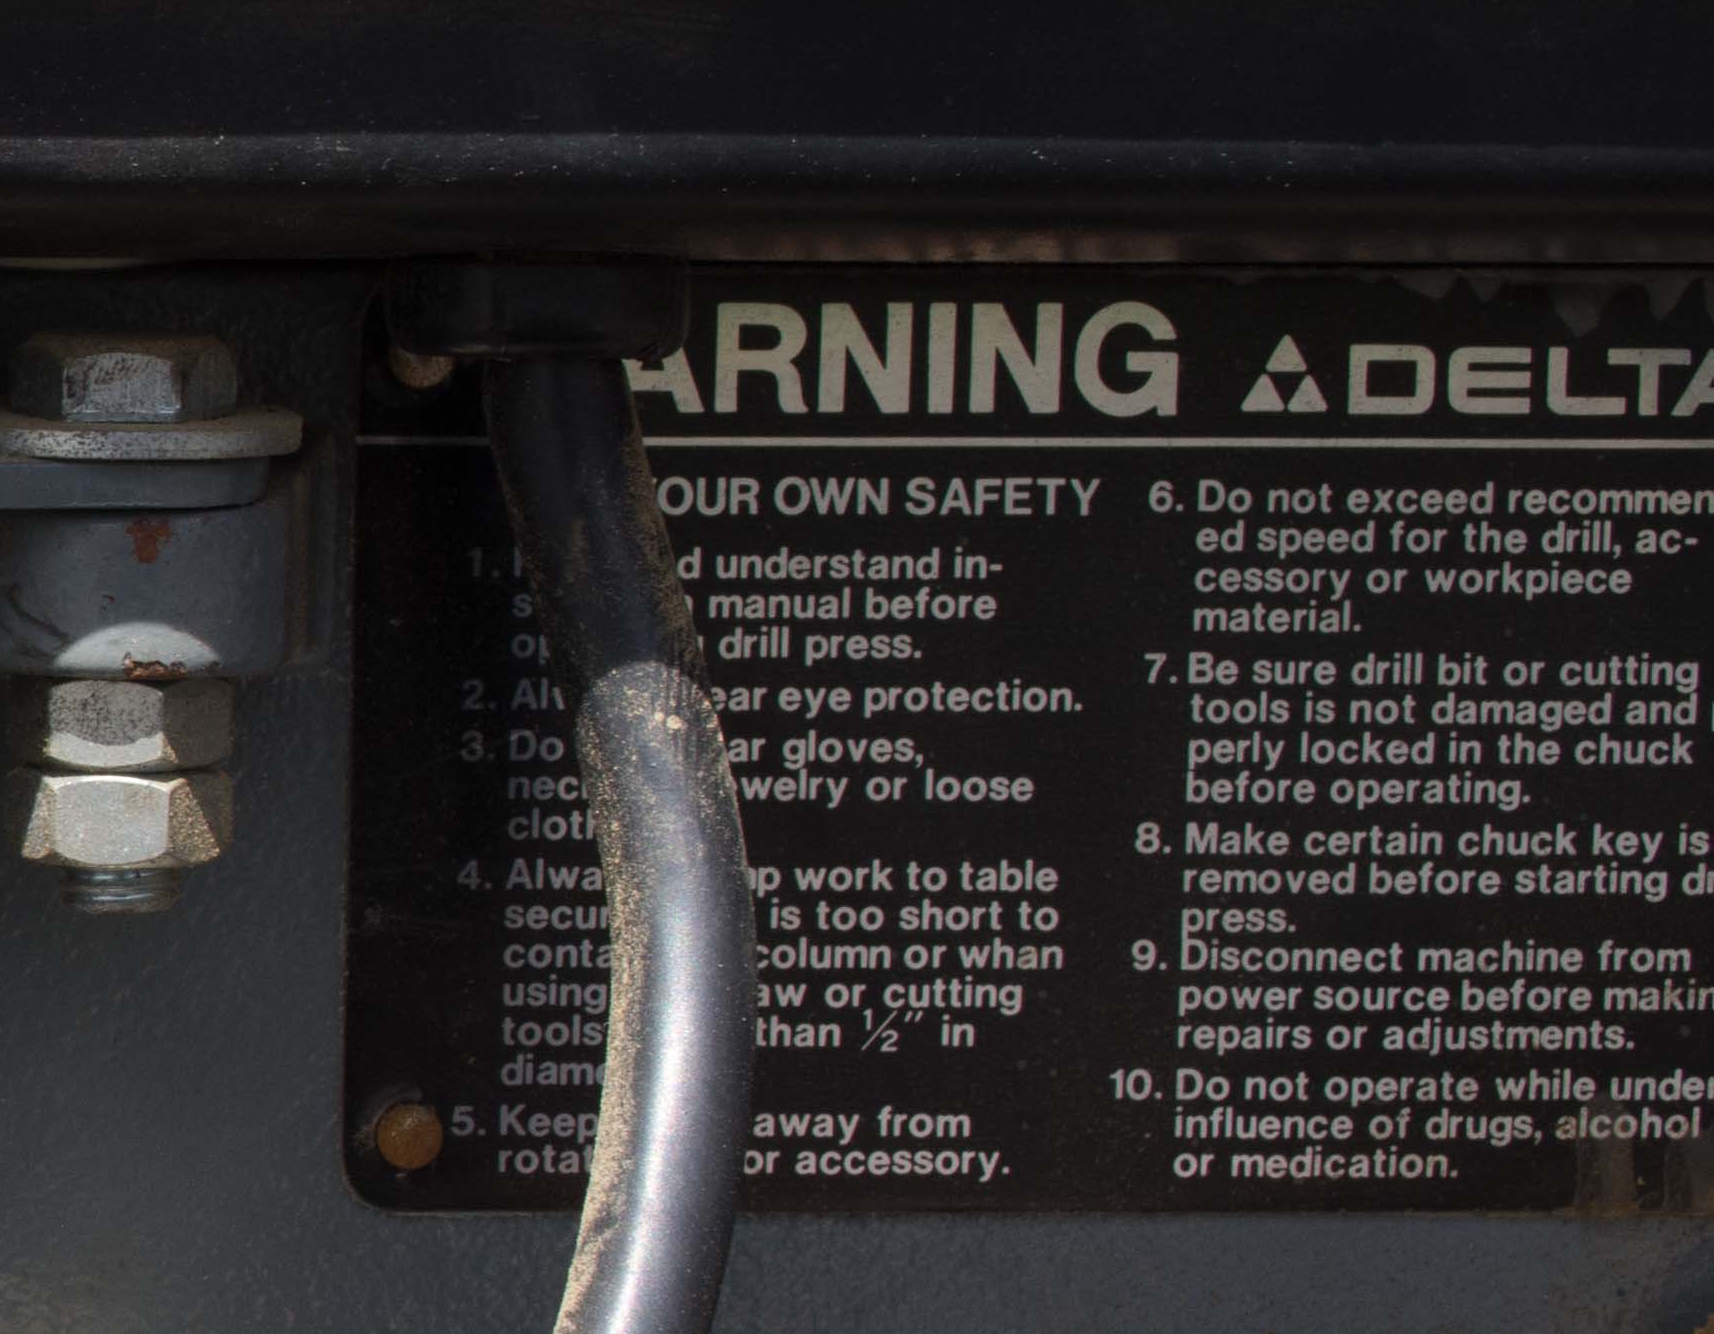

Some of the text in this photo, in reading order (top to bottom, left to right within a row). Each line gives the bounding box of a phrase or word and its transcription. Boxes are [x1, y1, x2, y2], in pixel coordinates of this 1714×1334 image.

[655, 476, 1101, 517] OUR OWN SAFETY
[1148, 478, 1714, 516] 6. Do not exceed recommen
[1195, 519, 1698, 560] ed speed for the drill, ac-
[715, 546, 941, 581] understand
[953, 546, 1003, 580] in-
[1194, 560, 1633, 601] cessory or workpiece
[708, 586, 851, 620] manual
[865, 586, 997, 620] before
[1193, 599, 1362, 634] material.
[718, 625, 790, 660] drill
[804, 634, 922, 667] press.
[1143, 651, 1699, 694] 7. Be sure drill bit or cutting
[710, 678, 1083, 720] ear eye protection.
[1190, 690, 1290, 724] tools
[1304, 690, 1336, 724] is
[1349, 694, 1417, 725] not
[1431, 691, 1613, 733] damaged
[1624, 689, 1698, 726] and
[509, 729, 564, 761] Do
[782, 729, 924, 771] gloves,
[1187, 730, 1693, 772] perly locked in the chuck
[739, 767, 1035, 808] welry or loose
[1185, 770, 1531, 812] before operating.
[1134, 821, 1710, 868] 8. Make certain chuck key is
[794, 858, 893, 892] work
[906, 861, 948, 892] to
[959, 858, 1059, 893] table
[1183, 861, 1357, 895] removed
[1368, 860, 1502, 896] before
[1514, 861, 1668, 903] starting
[770, 896, 1059, 932] is too short to
[1181, 903, 1297, 937] press.
[903, 944, 948, 970] or
[958, 936, 1064, 970] whan
[1131, 938, 1692, 973] 9. Disconnect machine from
[502, 974, 608, 1014] using
[758, 974, 1023, 1015] aw or cutting
[1177, 978, 1714, 1017] power source before makin
[941, 1014, 975, 1048] in
[1177, 1016, 1635, 1056] repairs or adjustments.
[1109, 1068, 1163, 1101] 10.
[1175, 1067, 1231, 1102] Do
[1244, 1071, 1309, 1102] not
[1323, 1071, 1479, 1108] operate
[1495, 1068, 1597, 1102] while
[452, 1104, 597, 1144] 5. Keep
[752, 1105, 971, 1146] away from
[1174, 1105, 1701, 1148] influence of drugs, alcohol
[794, 1150, 1010, 1183] accessory.
[1173, 1145, 1458, 1179] or medication.
